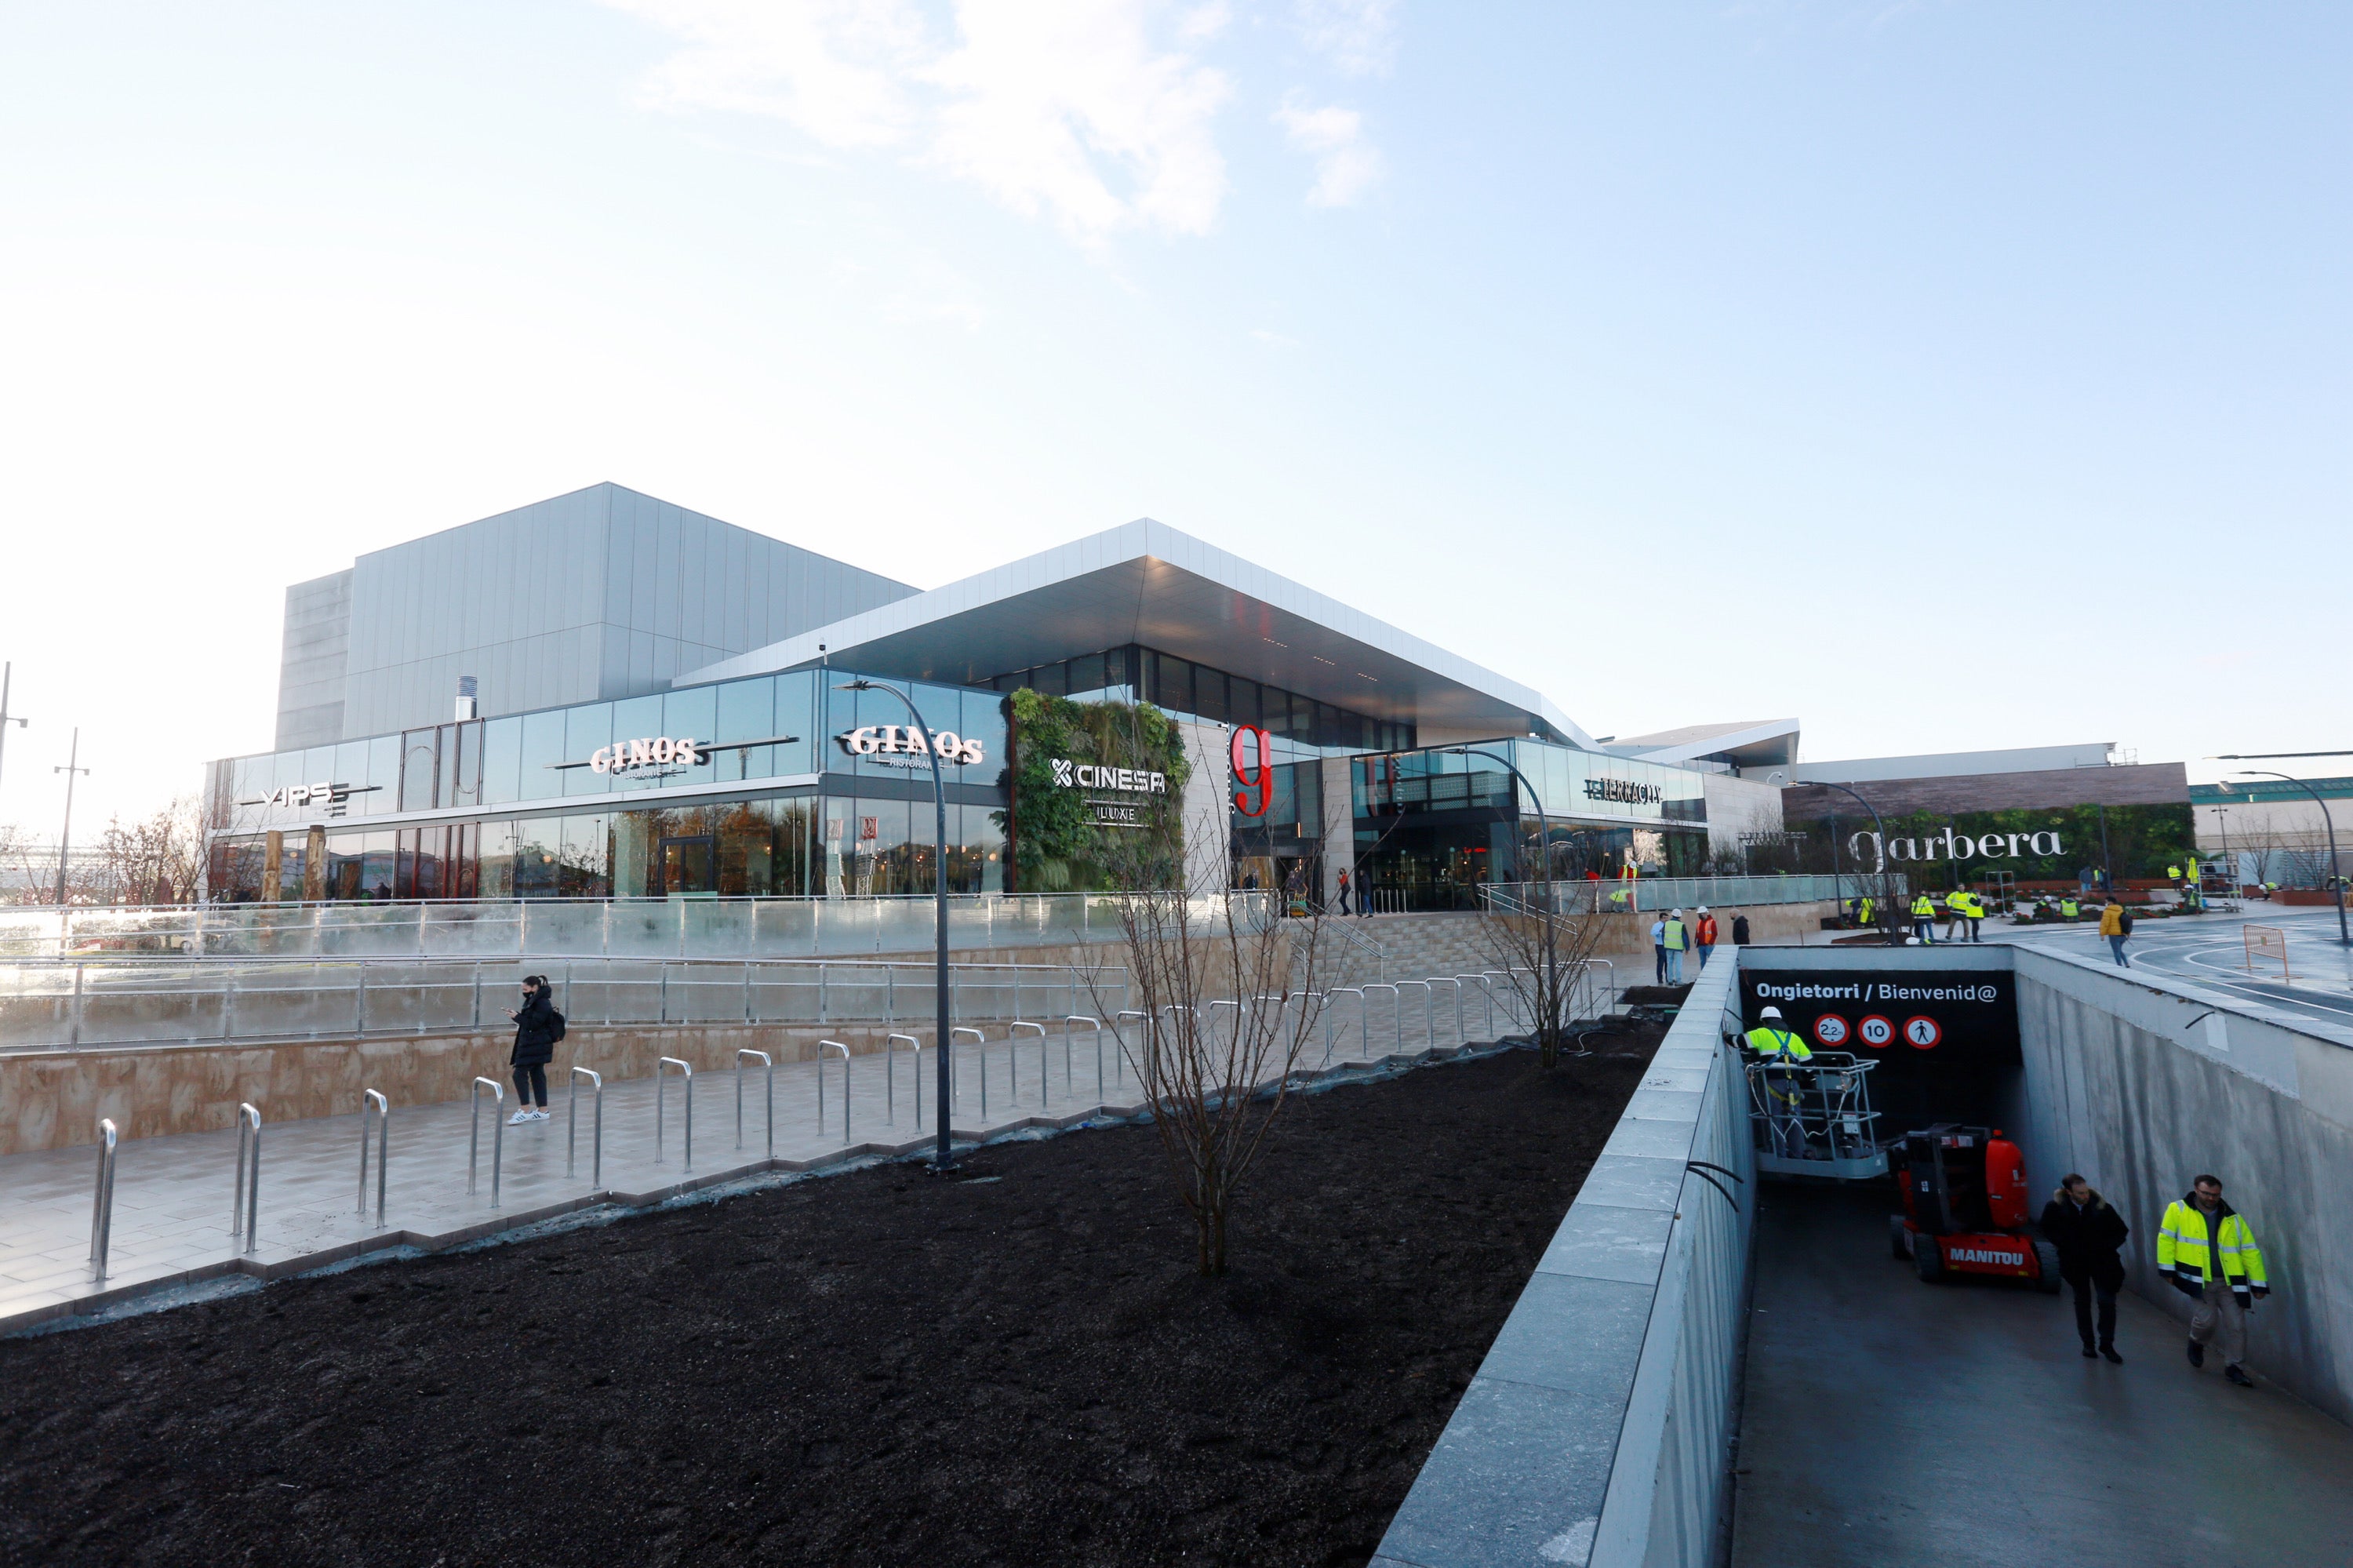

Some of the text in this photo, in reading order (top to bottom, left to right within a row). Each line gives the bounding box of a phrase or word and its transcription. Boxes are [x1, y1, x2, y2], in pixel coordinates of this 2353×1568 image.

[590, 737, 695, 773] GINOS
[850, 725, 983, 765] GINOS
[1075, 765, 1166, 793] CINESA
[259, 782, 334, 806] VIPS
[1099, 806, 1135, 820] LUXE
[1848, 827, 2068, 874] garbera
[1757, 983, 1860, 1001] Ongietorri
[1879, 984, 1997, 1002] Bienvenid@
[1867, 1024, 1885, 1037] 10
[1951, 1248, 2024, 1265] MANITOU
